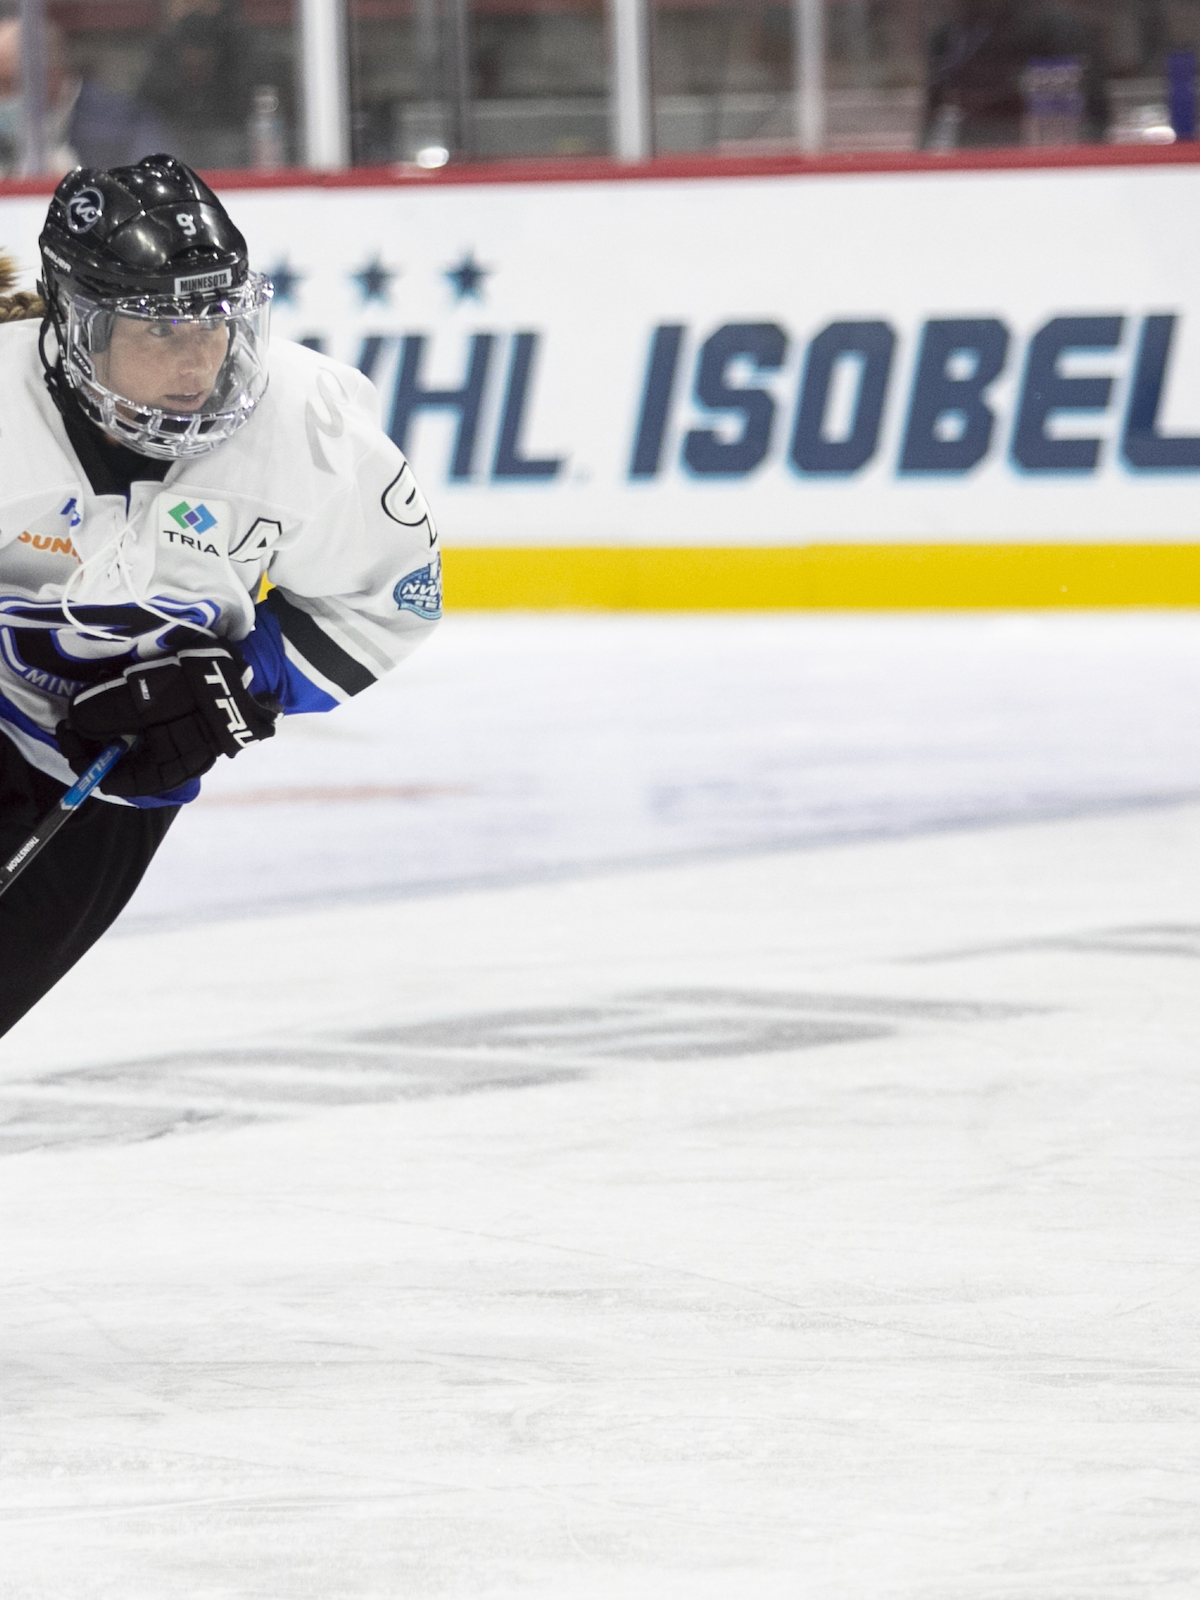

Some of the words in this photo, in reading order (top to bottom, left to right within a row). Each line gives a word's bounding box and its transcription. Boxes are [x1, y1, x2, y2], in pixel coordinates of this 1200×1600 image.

[176, 213, 197, 236] 9
[180, 272, 228, 293] MINNESOTA
[300, 332, 566, 482] HL
[624, 312, 1200, 483] ISOBEL
[162, 530, 221, 557] TRIA
[228, 516, 283, 563] A
[401, 581, 441, 597] NW
[25, 668, 84, 697] MIN
[6, 835, 41, 873] THUNSTROM
